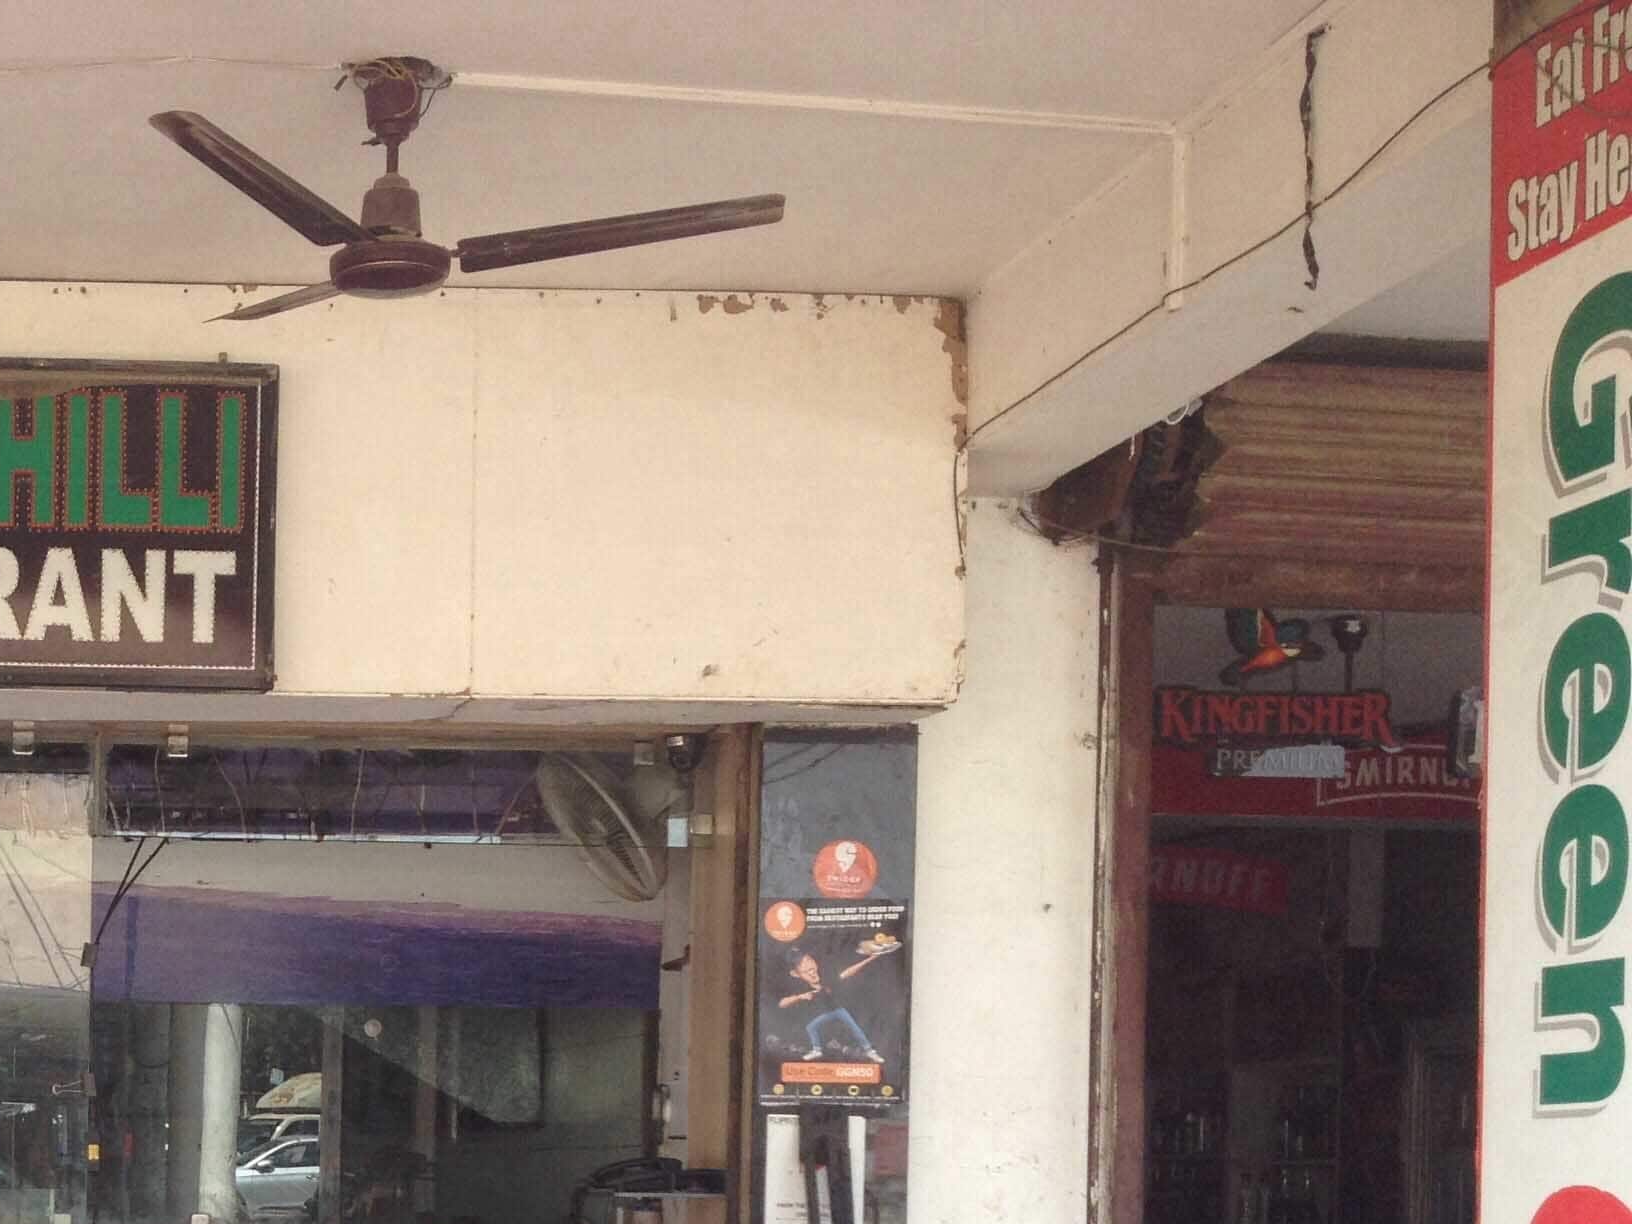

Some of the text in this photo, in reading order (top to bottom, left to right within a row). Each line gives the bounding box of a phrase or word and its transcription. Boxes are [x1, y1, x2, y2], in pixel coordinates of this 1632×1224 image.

[1535, 27, 1586, 129] Eat
[1506, 128, 1632, 262] Stay He
[1159, 690, 1395, 747] KINGFISHER
[1539, 271, 1632, 1105] Green
